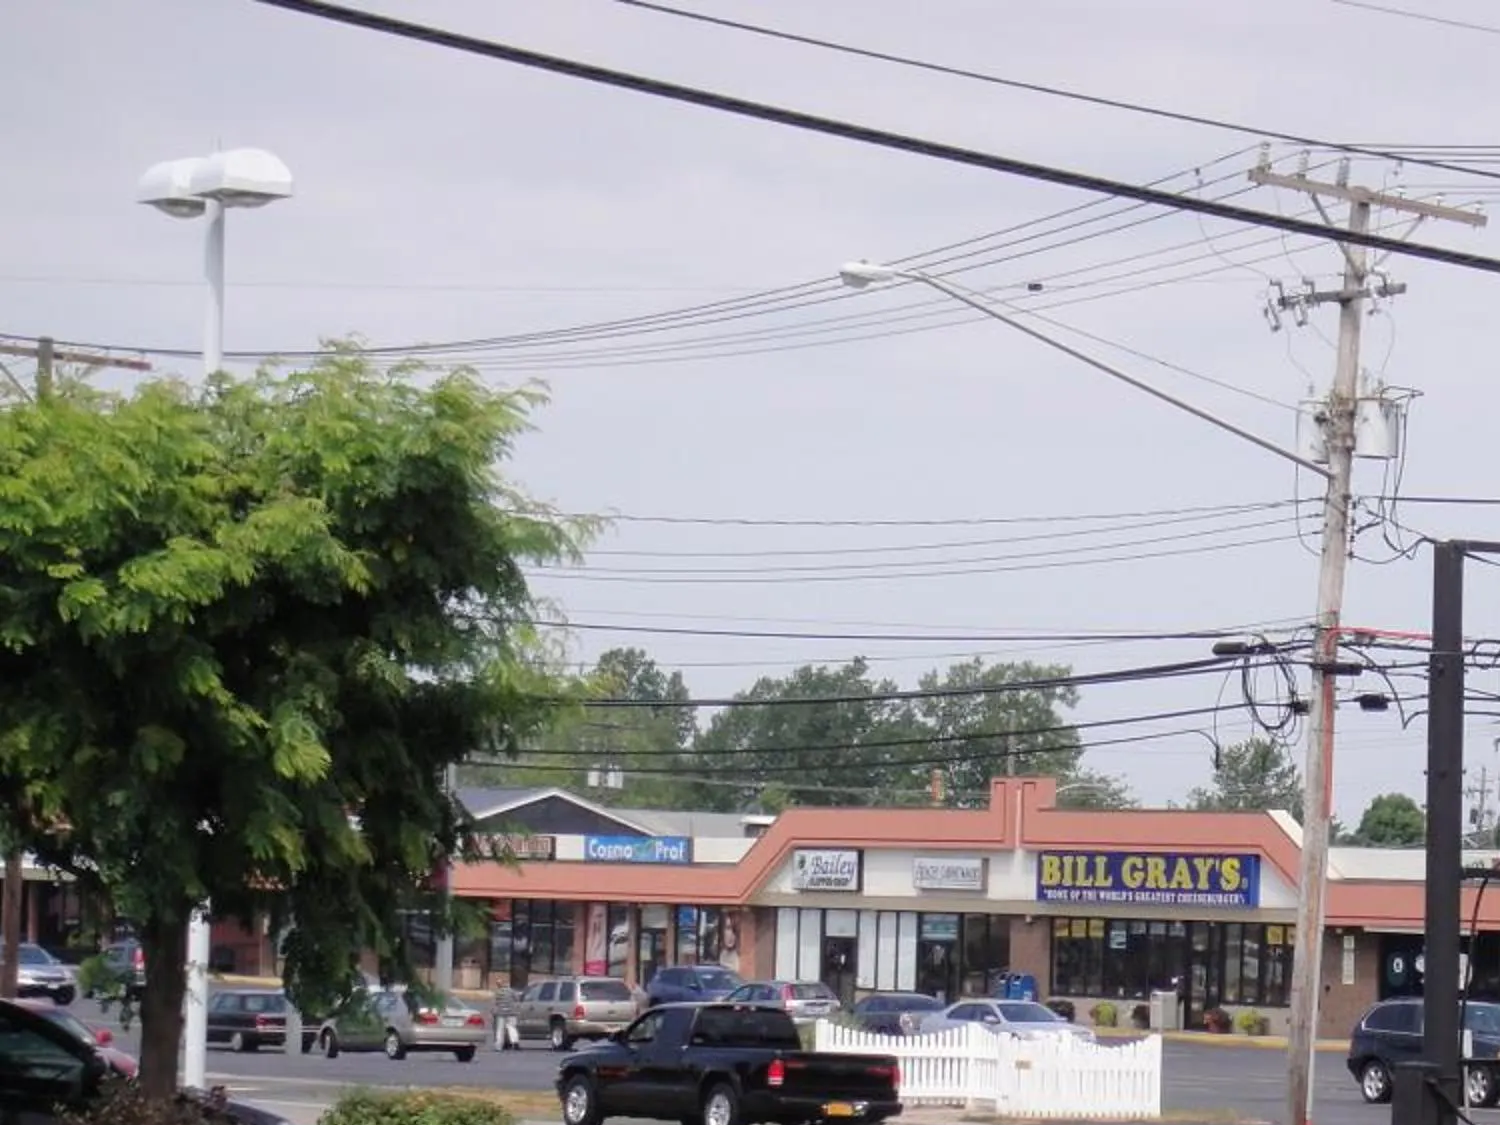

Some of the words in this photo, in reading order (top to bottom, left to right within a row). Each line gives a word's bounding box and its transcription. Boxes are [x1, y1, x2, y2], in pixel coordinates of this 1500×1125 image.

[588, 837, 633, 860] Cosmo
[811, 852, 857, 882] Bailey
[1040, 854, 1113, 888] BILL
[1121, 855, 1242, 891] GRAY'S
